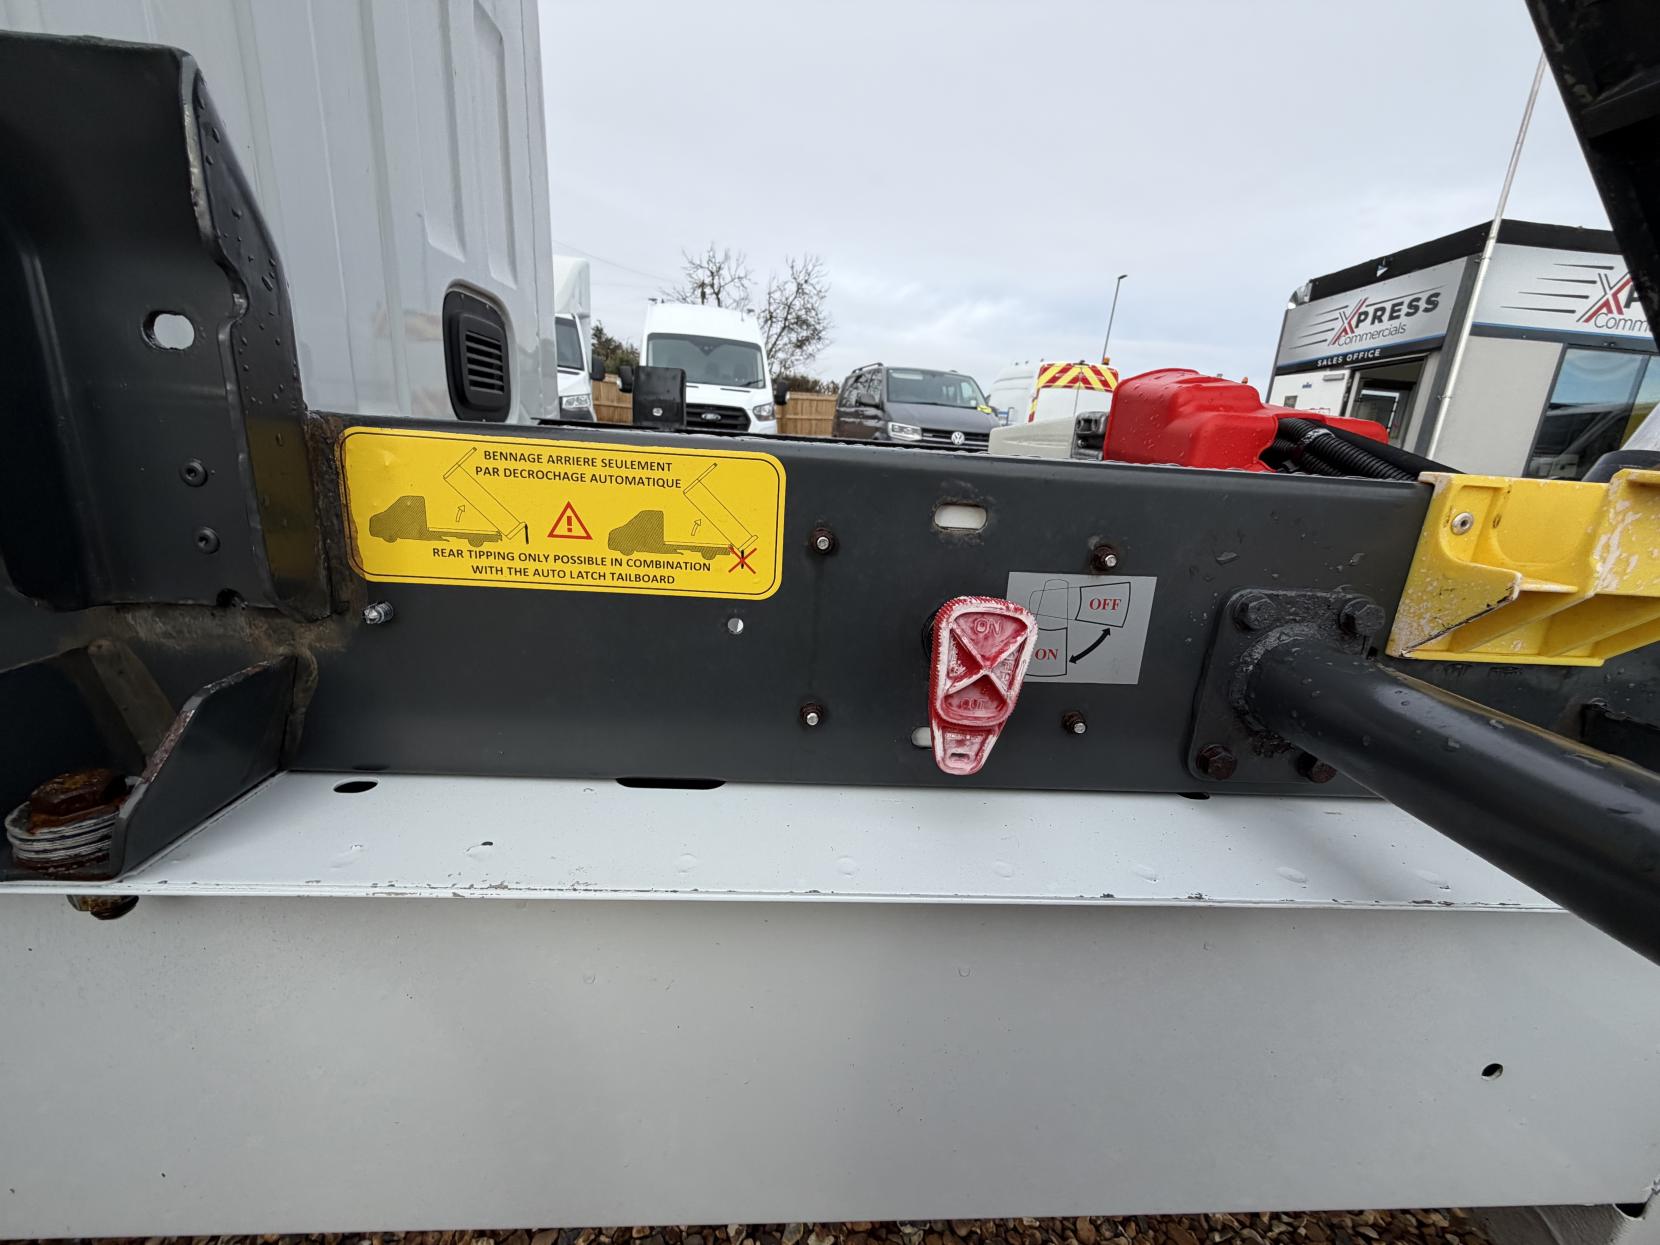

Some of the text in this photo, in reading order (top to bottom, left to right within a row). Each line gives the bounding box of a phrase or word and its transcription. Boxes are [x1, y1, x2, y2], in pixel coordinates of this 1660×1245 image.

[1328, 291, 1441, 346] XPRESS
[1337, 322, 1407, 347] Commercials
[1316, 348, 1381, 368] SALES OFFICE
[484, 450, 672, 472] BENNAGE ARRIERE SEULEMENT
[475, 466, 681, 489] PAR DECROCHAGE AUTOMATIQUE
[432, 547, 711, 572] REAR TIPPING ONLY POSSIBLE IN COMBINATION
[471, 565, 675, 584] WITH THE AUTO LATCH TAILBOARD
[1089, 598, 1122, 611] OFF
[1034, 647, 1059, 661] ON
